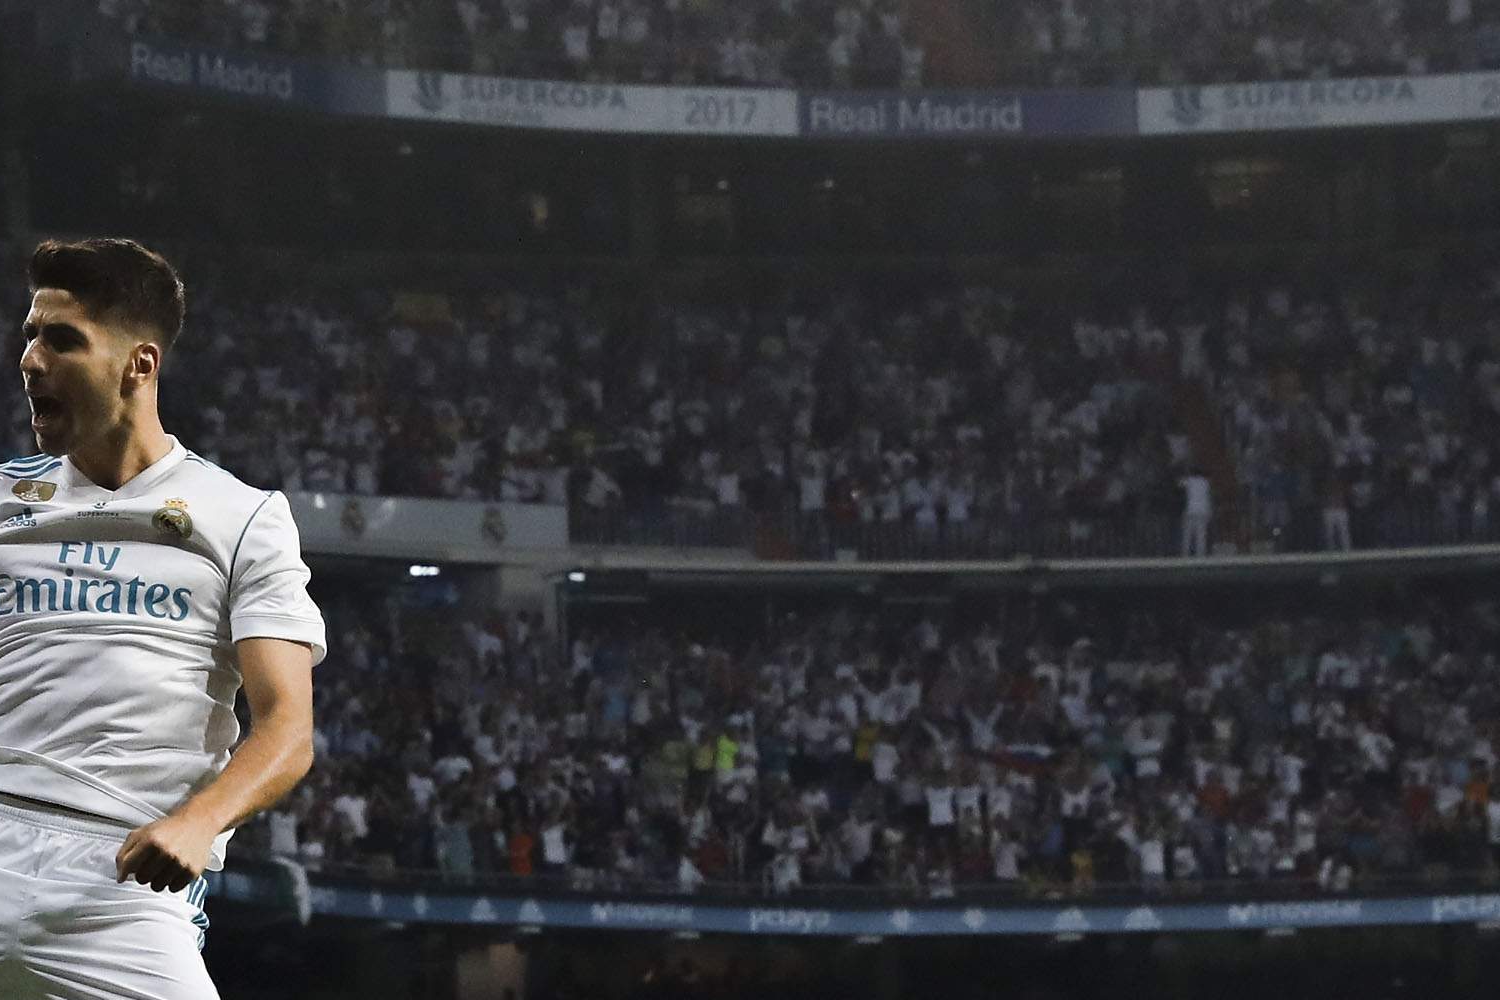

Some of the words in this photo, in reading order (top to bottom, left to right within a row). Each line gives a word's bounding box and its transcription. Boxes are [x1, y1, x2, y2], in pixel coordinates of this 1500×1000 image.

[130, 42, 191, 85] Real
[198, 53, 293, 101] Madrid
[684, 95, 758, 128] 2017
[810, 96, 885, 131] Real
[897, 96, 1023, 132] Madrid
[58, 541, 121, 571] Fly
